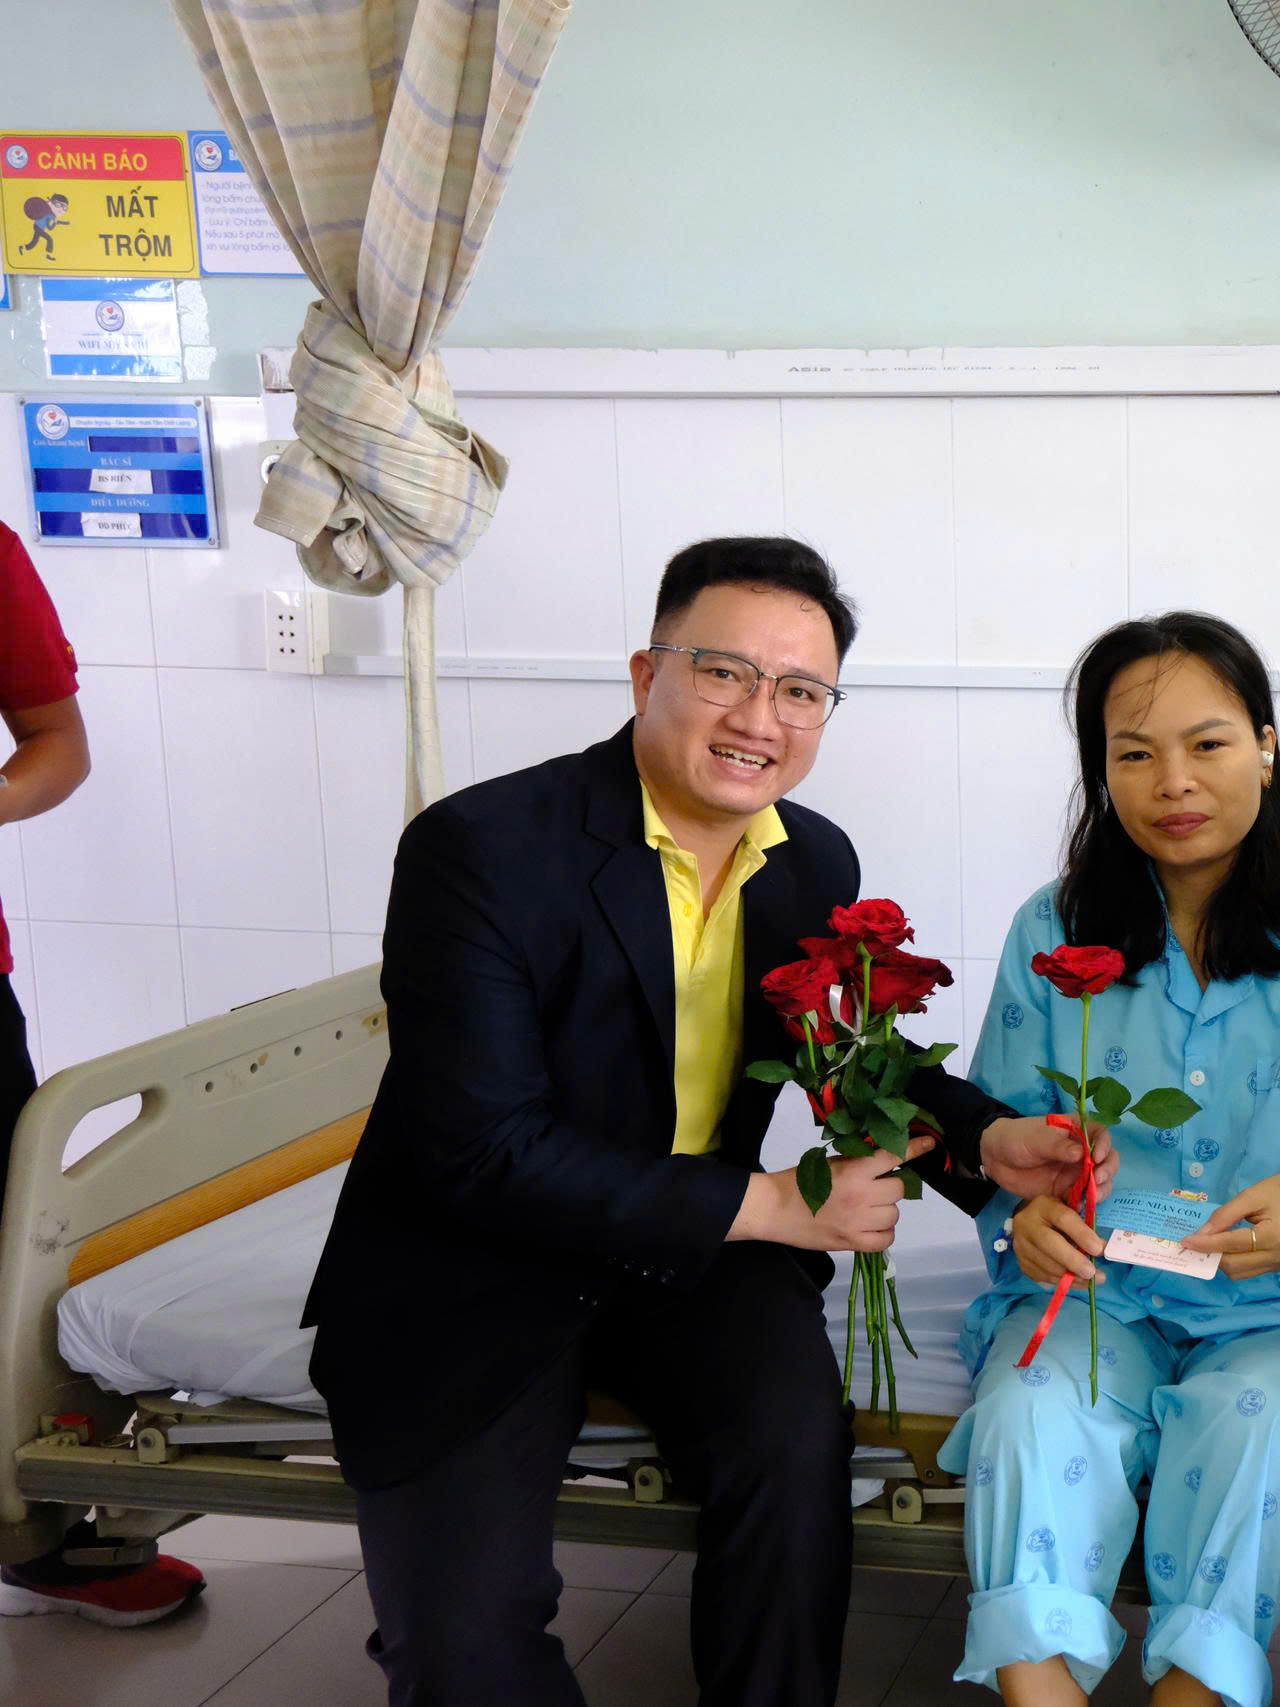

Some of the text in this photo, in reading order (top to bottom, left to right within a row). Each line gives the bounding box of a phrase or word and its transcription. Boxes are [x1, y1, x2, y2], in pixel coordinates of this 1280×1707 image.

[38, 145, 148, 171] CẢNH BÁO
[106, 186, 159, 218] MẤT
[99, 229, 173, 262] TRỘM
[1113, 1197, 1145, 1207] PHIẾU
[1146, 1200, 1177, 1213] NHẬN
[1177, 1206, 1202, 1219] CƠM
